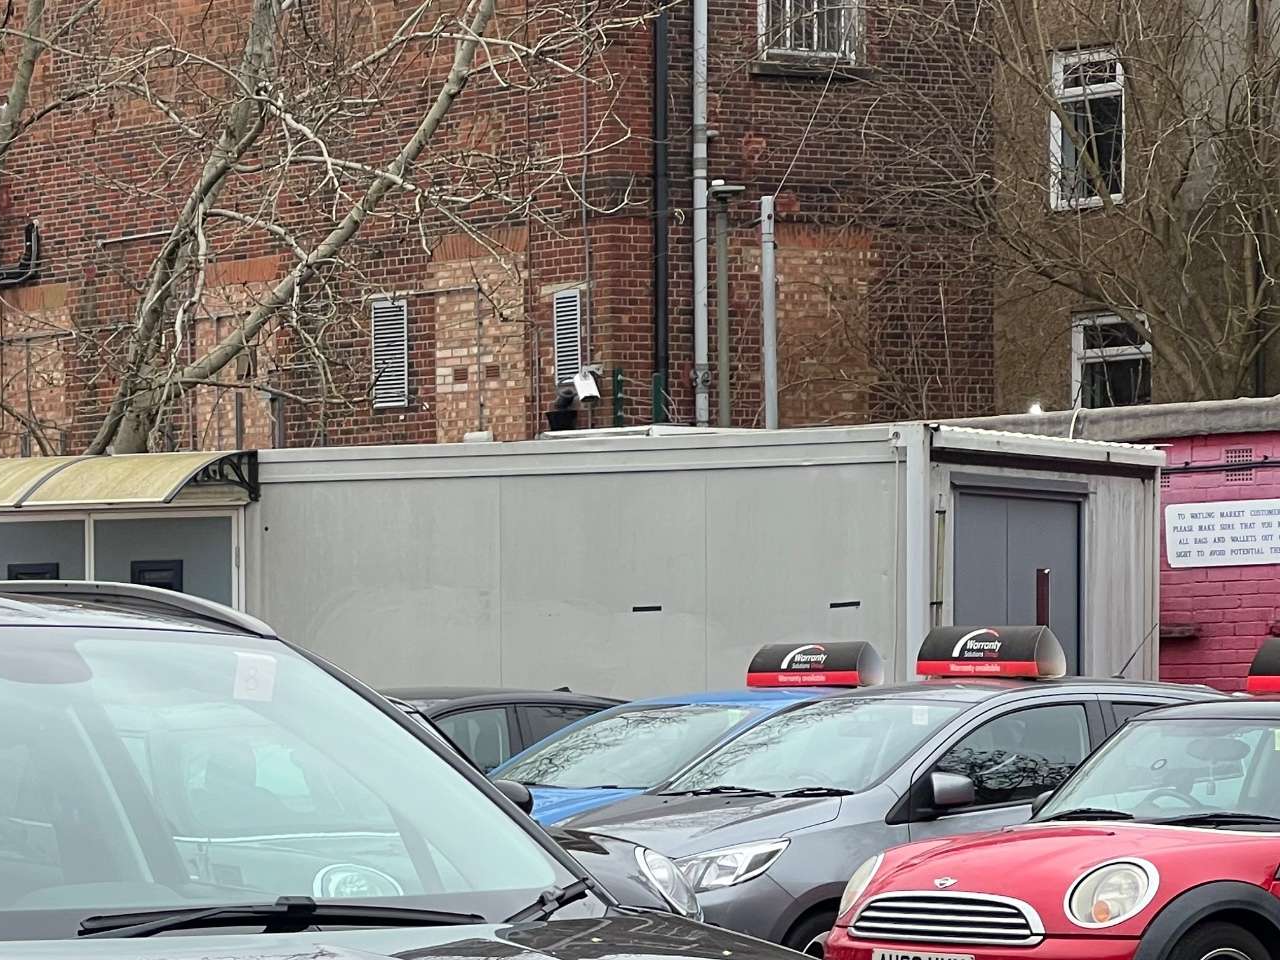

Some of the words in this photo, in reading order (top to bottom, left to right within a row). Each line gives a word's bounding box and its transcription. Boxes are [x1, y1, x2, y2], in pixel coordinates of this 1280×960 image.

[1231, 547, 1264, 555] POTENTIAL
[967, 639, 1001, 652] Warranty
[794, 653, 827, 664] Warranty
